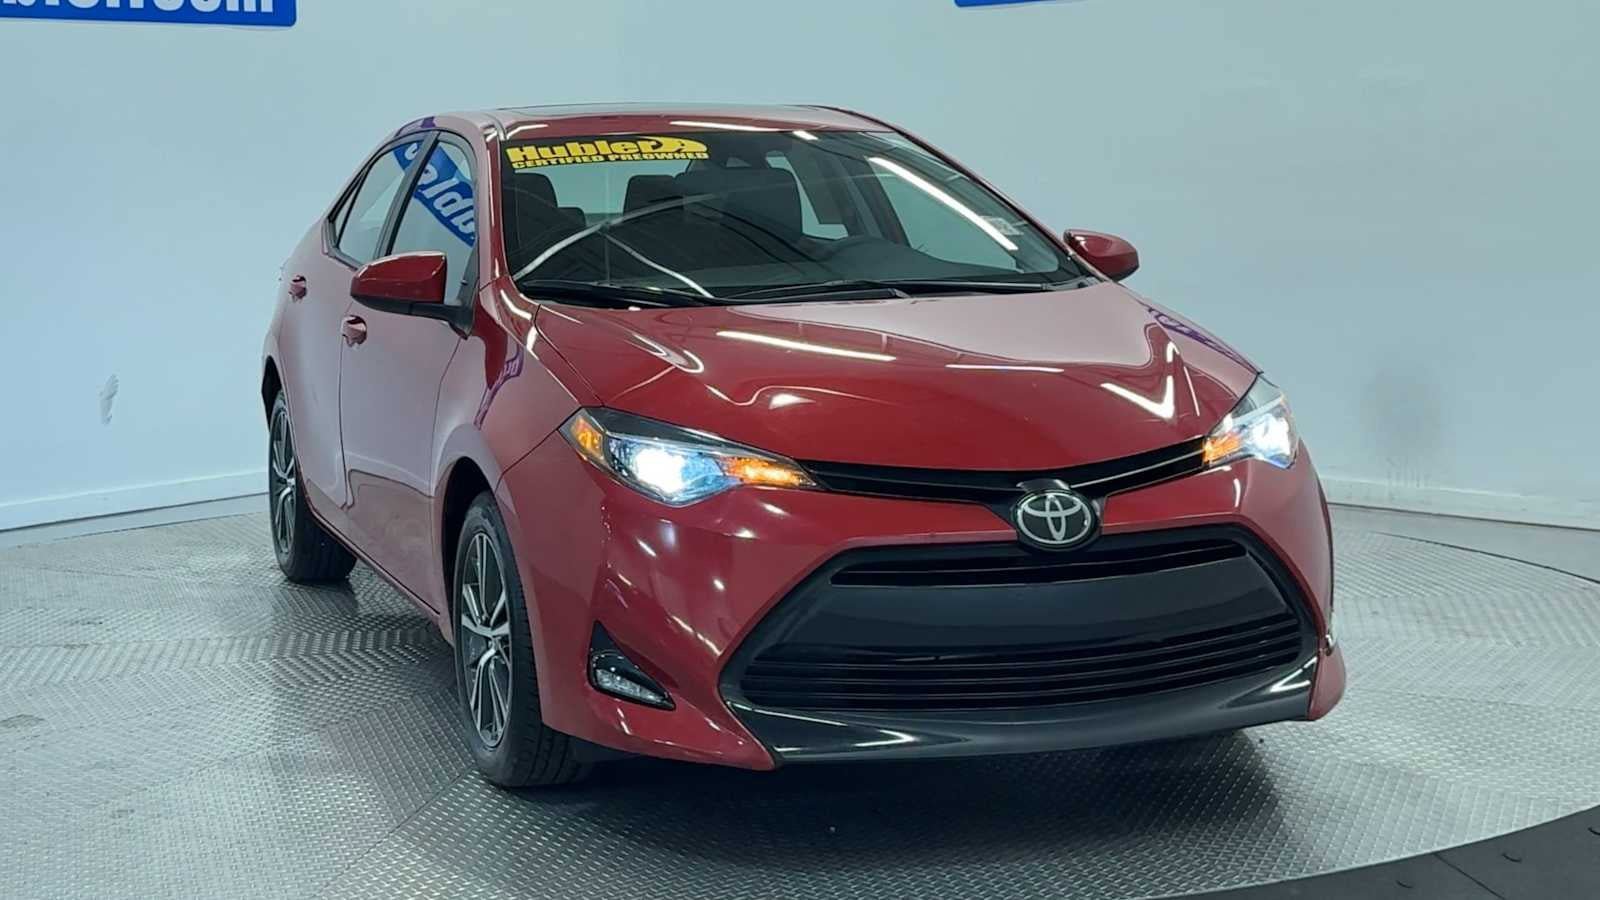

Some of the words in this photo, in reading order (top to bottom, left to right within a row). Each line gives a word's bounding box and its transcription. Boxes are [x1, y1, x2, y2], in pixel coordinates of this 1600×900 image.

[506, 140, 658, 162] Hubler
[512, 154, 605, 169] CERTIFIED
[607, 152, 710, 161] PREOWNED
